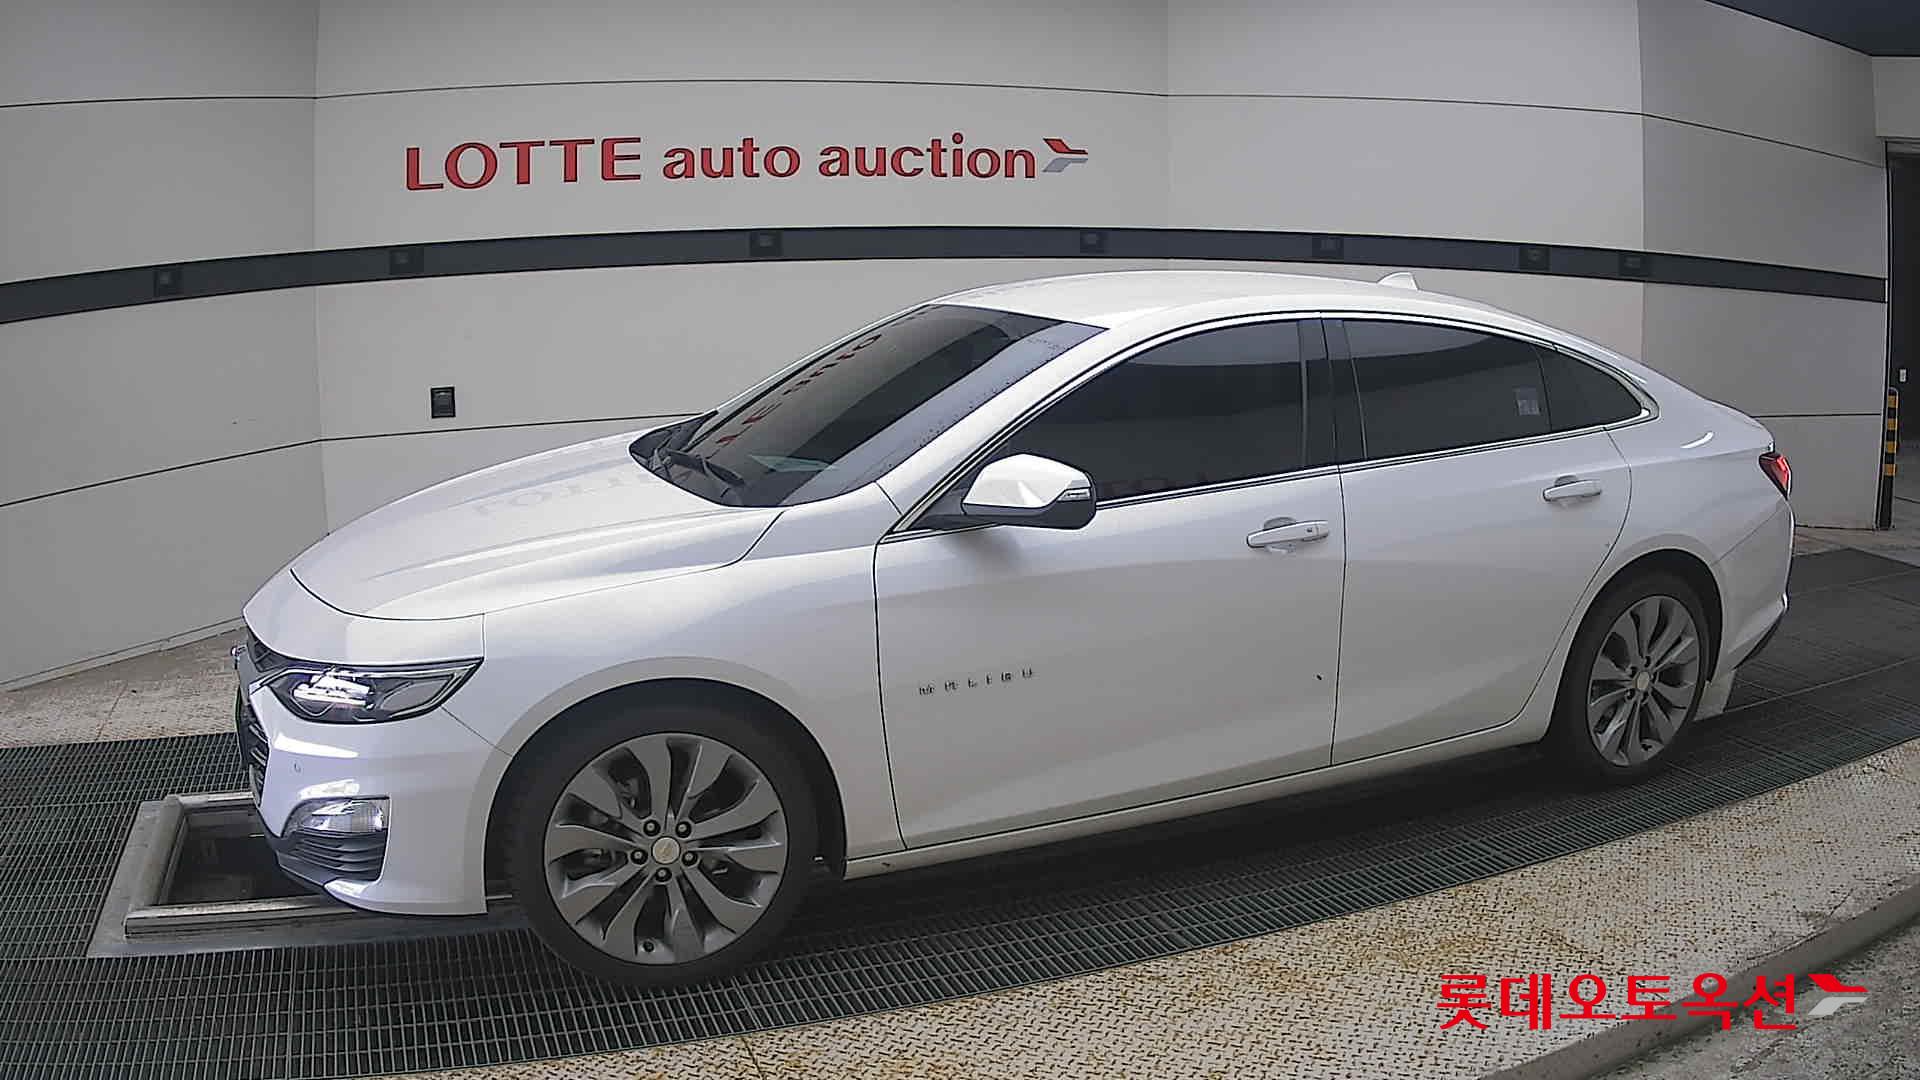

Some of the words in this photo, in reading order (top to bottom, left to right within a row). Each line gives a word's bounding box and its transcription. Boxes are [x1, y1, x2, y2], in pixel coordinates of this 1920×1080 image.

[405, 136, 642, 192] LOTTE
[662, 137, 801, 181] auto
[818, 132, 1038, 179] auction
